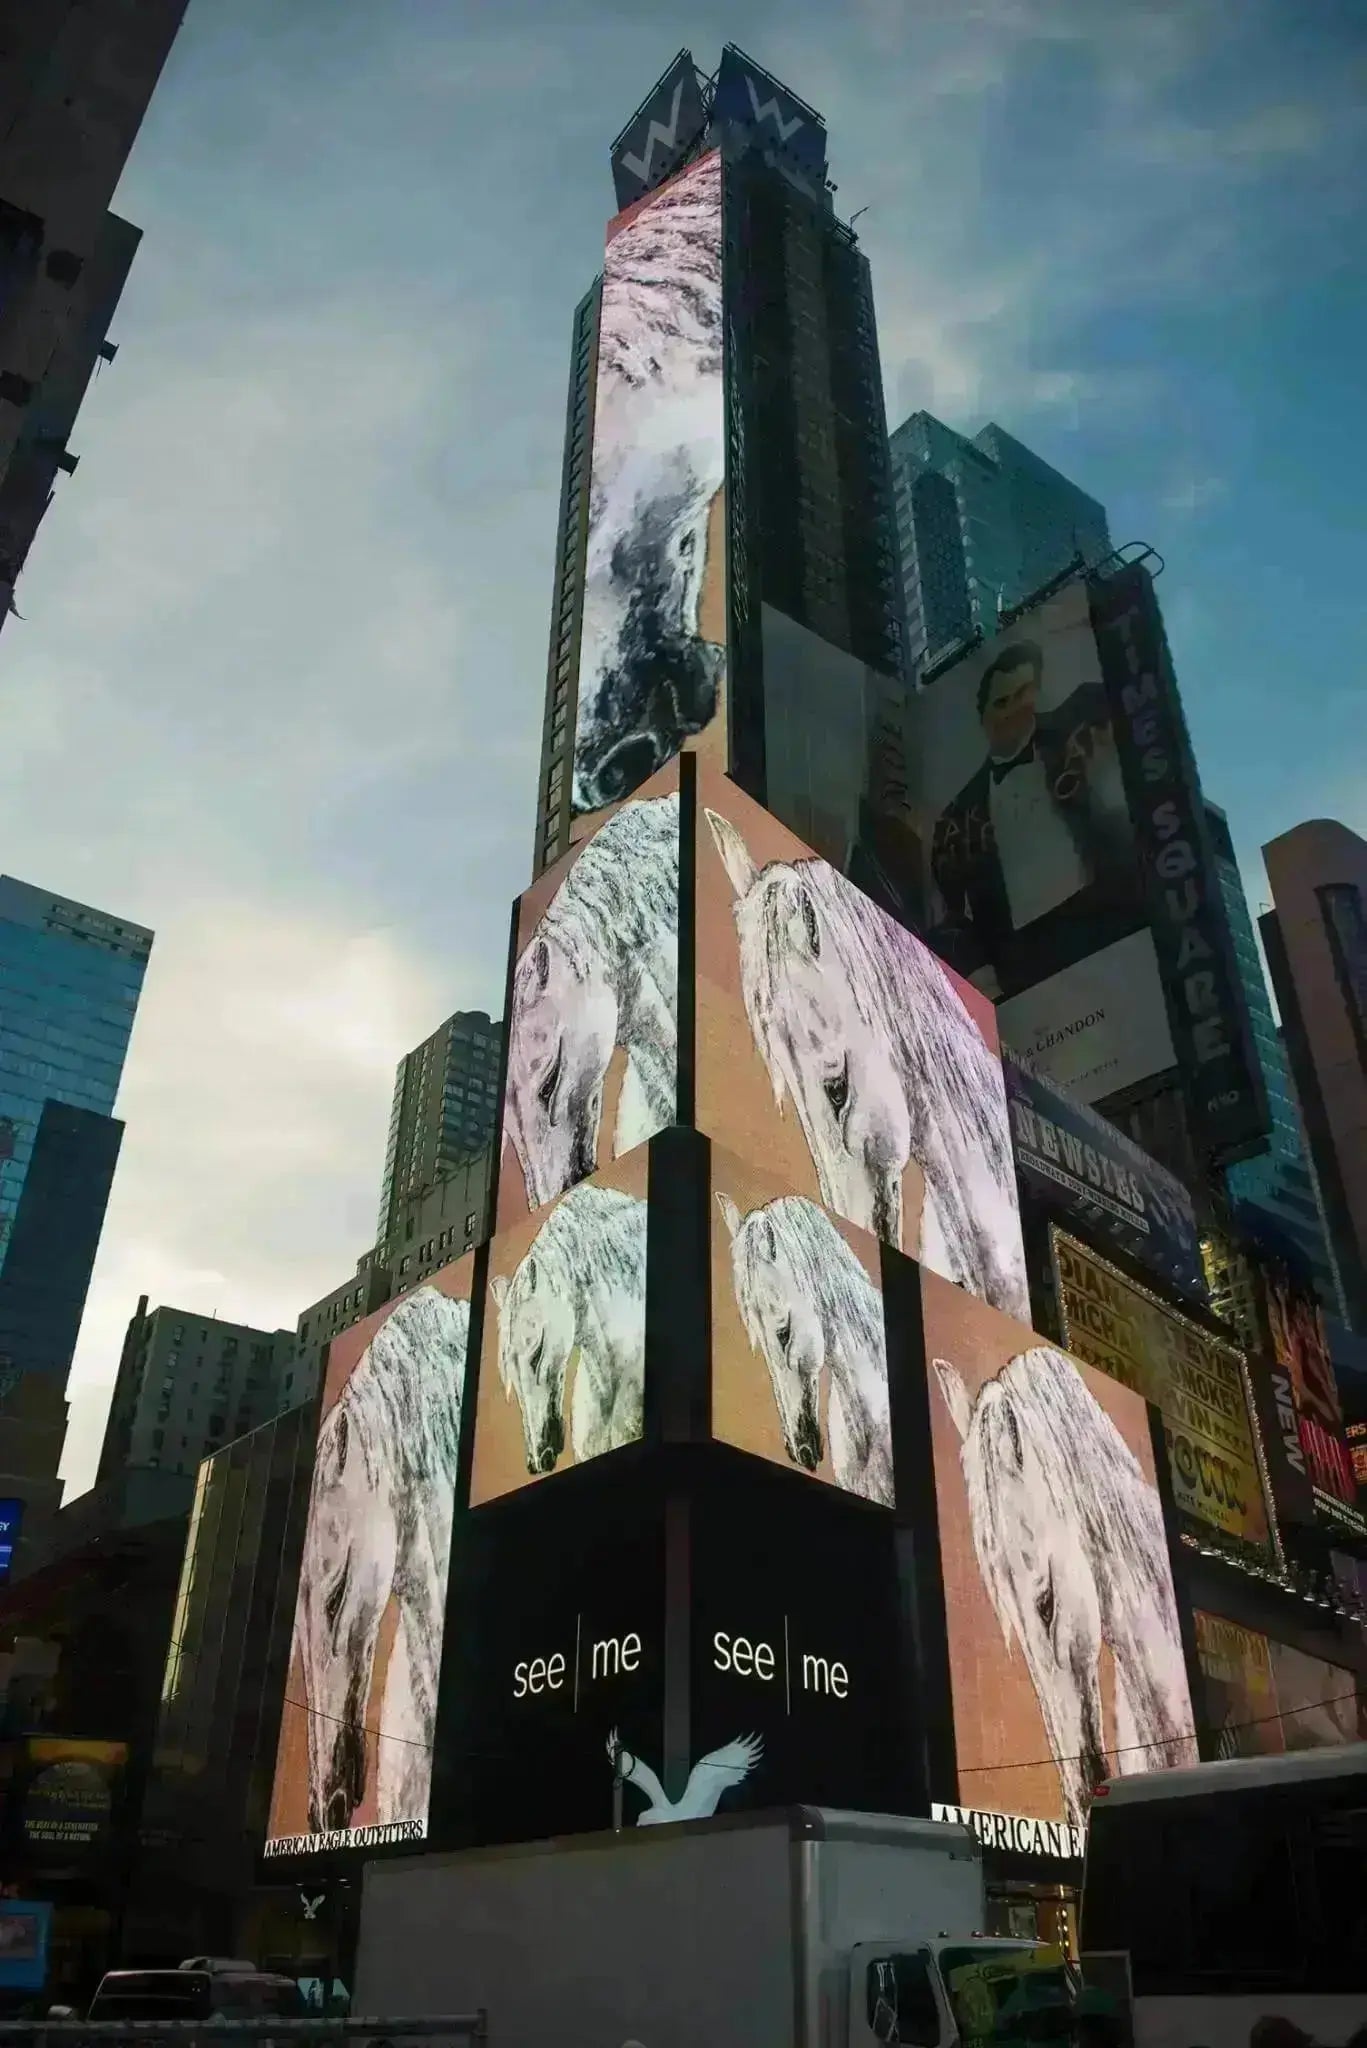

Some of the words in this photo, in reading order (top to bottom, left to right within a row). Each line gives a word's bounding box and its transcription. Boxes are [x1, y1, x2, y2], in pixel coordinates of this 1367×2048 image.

[620, 76, 685, 184] W
[743, 73, 806, 142] W
[1103, 603, 1168, 783] TIMES
[1151, 799, 1231, 1064] SQUARE
[1035, 1007, 1107, 1053] CHANDON
[1010, 1098, 1146, 1213] NEWSIES
[1168, 1356, 1241, 1422] SMOKEY
[1270, 1372, 1307, 1477] NEW
[513, 1653, 566, 1698] see
[592, 1632, 642, 1680] me
[713, 1631, 775, 1681] see
[802, 1653, 849, 1699] me
[264, 1834, 318, 1859] AMERICAN
[319, 1828, 352, 1853] EAGLE
[353, 1819, 424, 1847] OUTFITTERS
[940, 1806, 1063, 1859] AMERICAN
